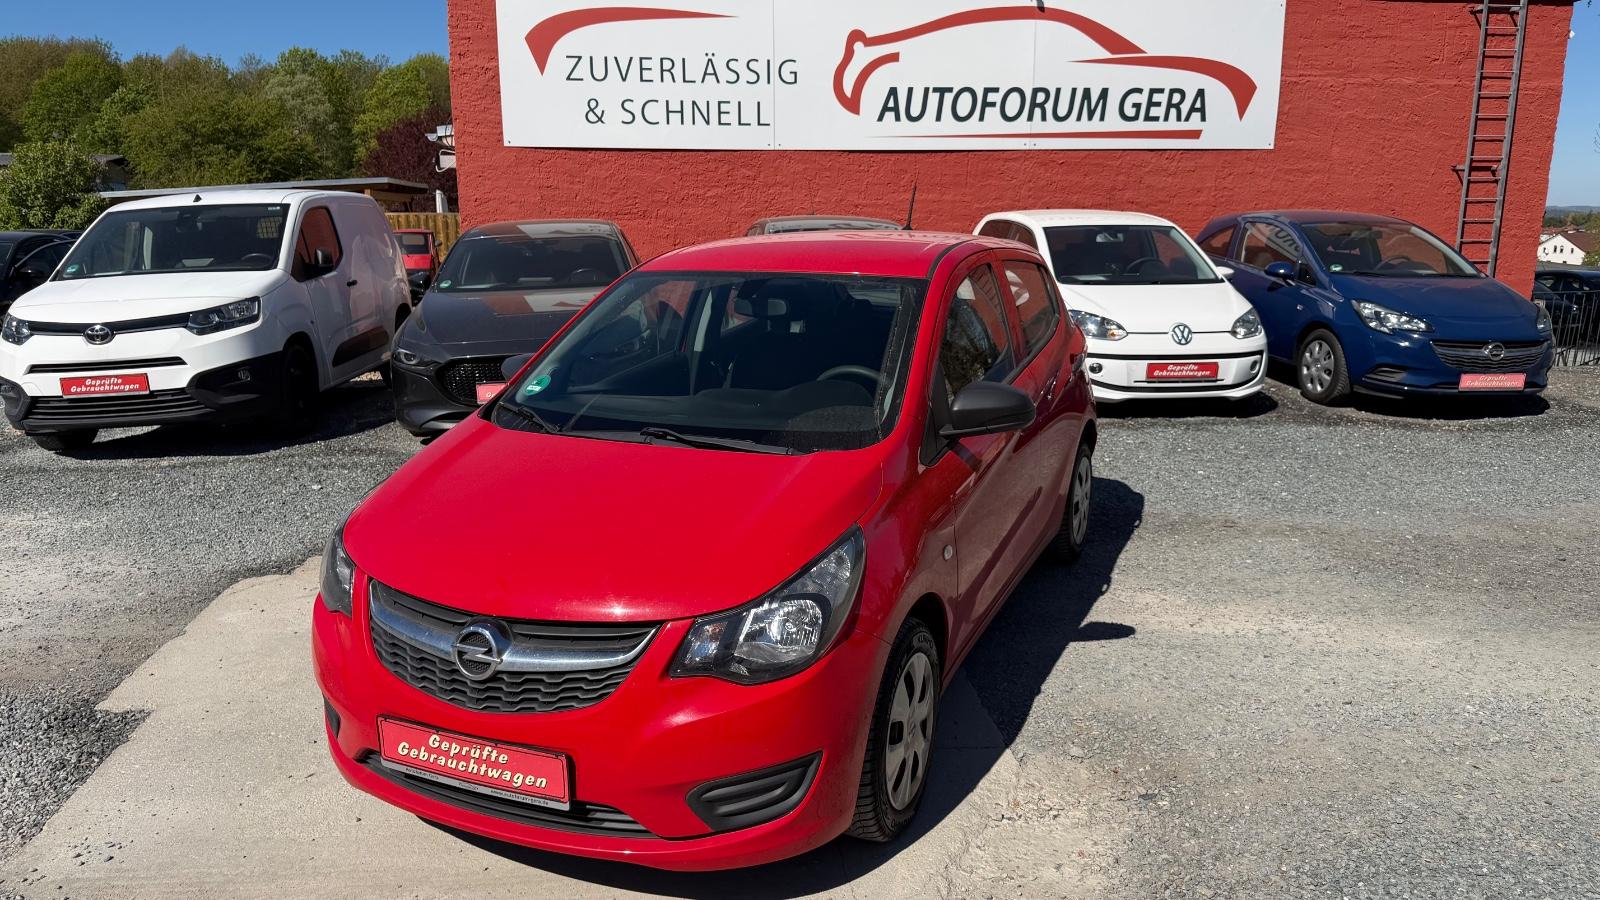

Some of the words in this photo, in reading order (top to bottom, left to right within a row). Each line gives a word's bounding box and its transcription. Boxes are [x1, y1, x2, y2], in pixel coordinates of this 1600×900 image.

[565, 52, 798, 85] ZUVERLÄSSIG
[584, 98, 605, 125] &
[620, 98, 771, 127] SCHNELL
[876, 86, 1110, 123] AUTOFORUM
[1118, 87, 1207, 123] GERA
[70, 383, 139, 392] Gebrauchtwagen
[85, 377, 122, 386] Geprüfte
[428, 734, 509, 764] Geprüfte
[397, 741, 548, 789] Gebrauchtwagen
